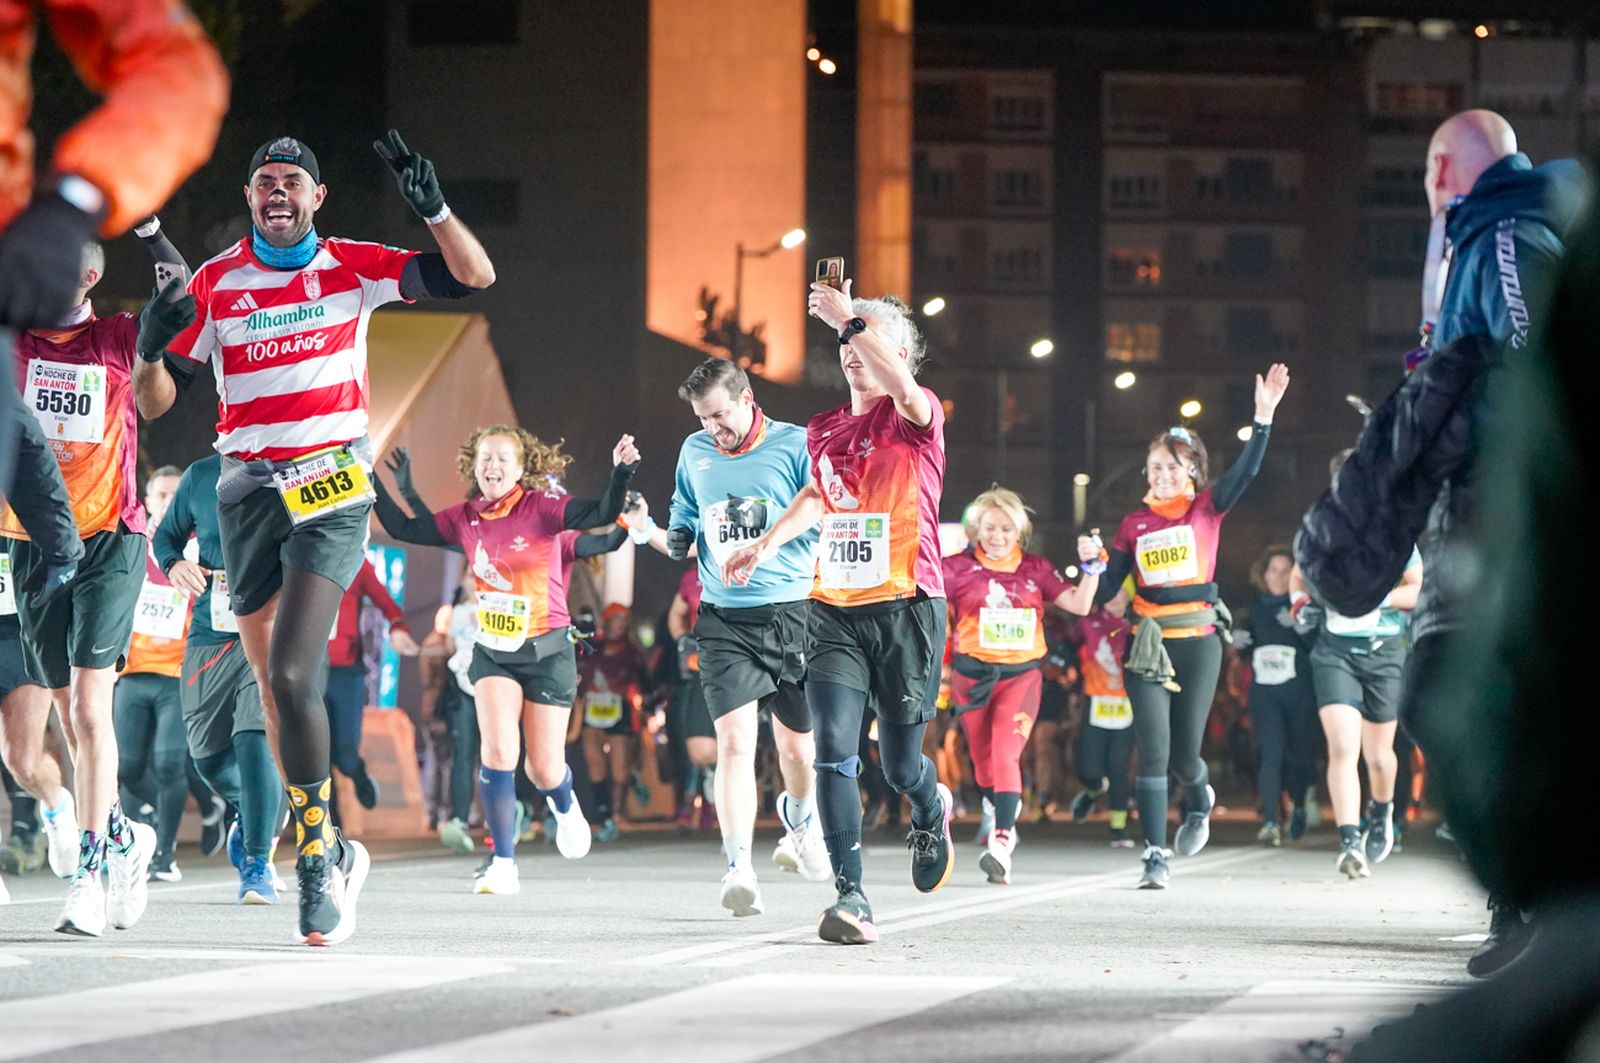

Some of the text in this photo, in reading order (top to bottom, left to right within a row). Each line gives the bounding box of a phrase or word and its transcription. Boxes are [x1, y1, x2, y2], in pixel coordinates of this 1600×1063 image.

[242, 305, 325, 333] Alhambra
[245, 332, 329, 362] 100 años
[33, 378, 48, 387] SAN
[43, 370, 77, 381] NOCHE DE
[36, 388, 92, 416] 5530
[284, 479, 302, 491] SAN
[299, 471, 354, 504] 4613
[849, 521, 858, 530] DE
[828, 540, 872, 563] 2105
[1144, 546, 1188, 567] 13082
[141, 602, 175, 619] 2572
[484, 612, 516, 632] 4105
